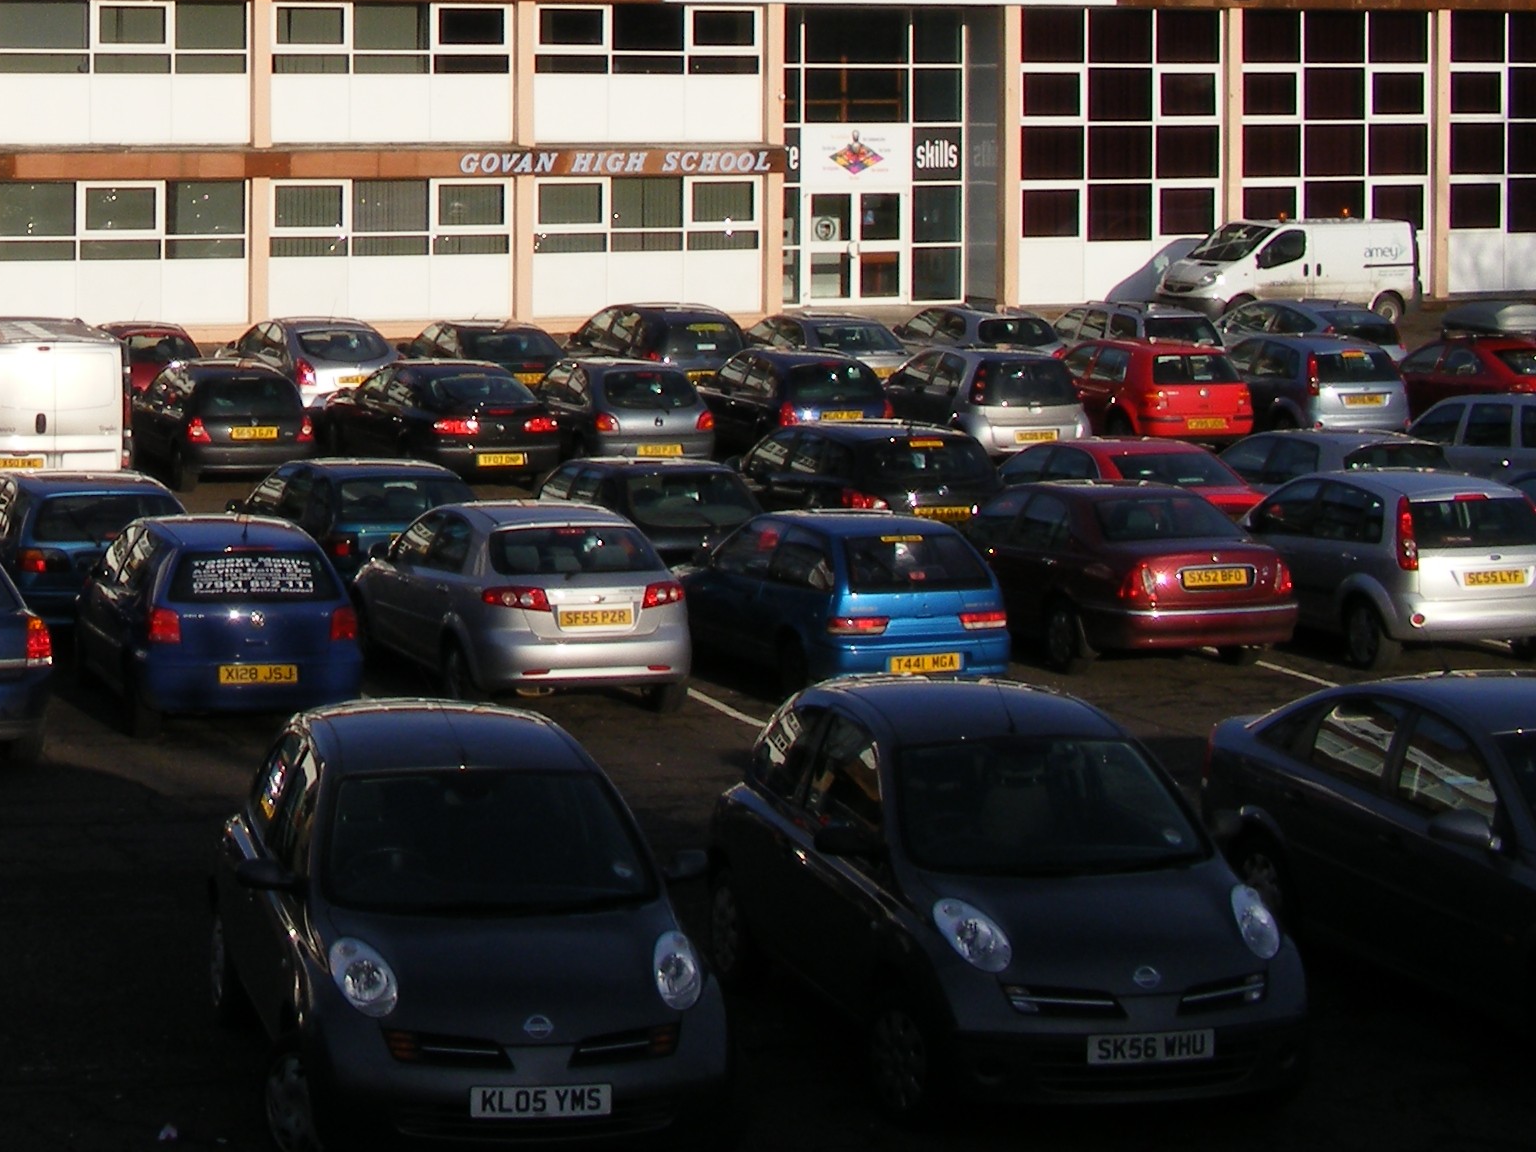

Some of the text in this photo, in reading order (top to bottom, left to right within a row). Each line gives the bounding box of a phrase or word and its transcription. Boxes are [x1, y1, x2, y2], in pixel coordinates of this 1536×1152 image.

[916, 139, 958, 169] skills
[460, 151, 772, 173] GOVAN HIGH SCHOOL
[1364, 246, 1398, 260] amey
[1188, 570, 1219, 584] SX52
[1468, 569, 1520, 584] SC55 LYF
[565, 609, 626, 624] SF55 PZR
[896, 654, 955, 670] T441 MGA
[225, 668, 293, 680] X128 JSJ
[1097, 1033, 1205, 1060] SK56 WHU
[481, 1087, 601, 1113] KL05 YMS
